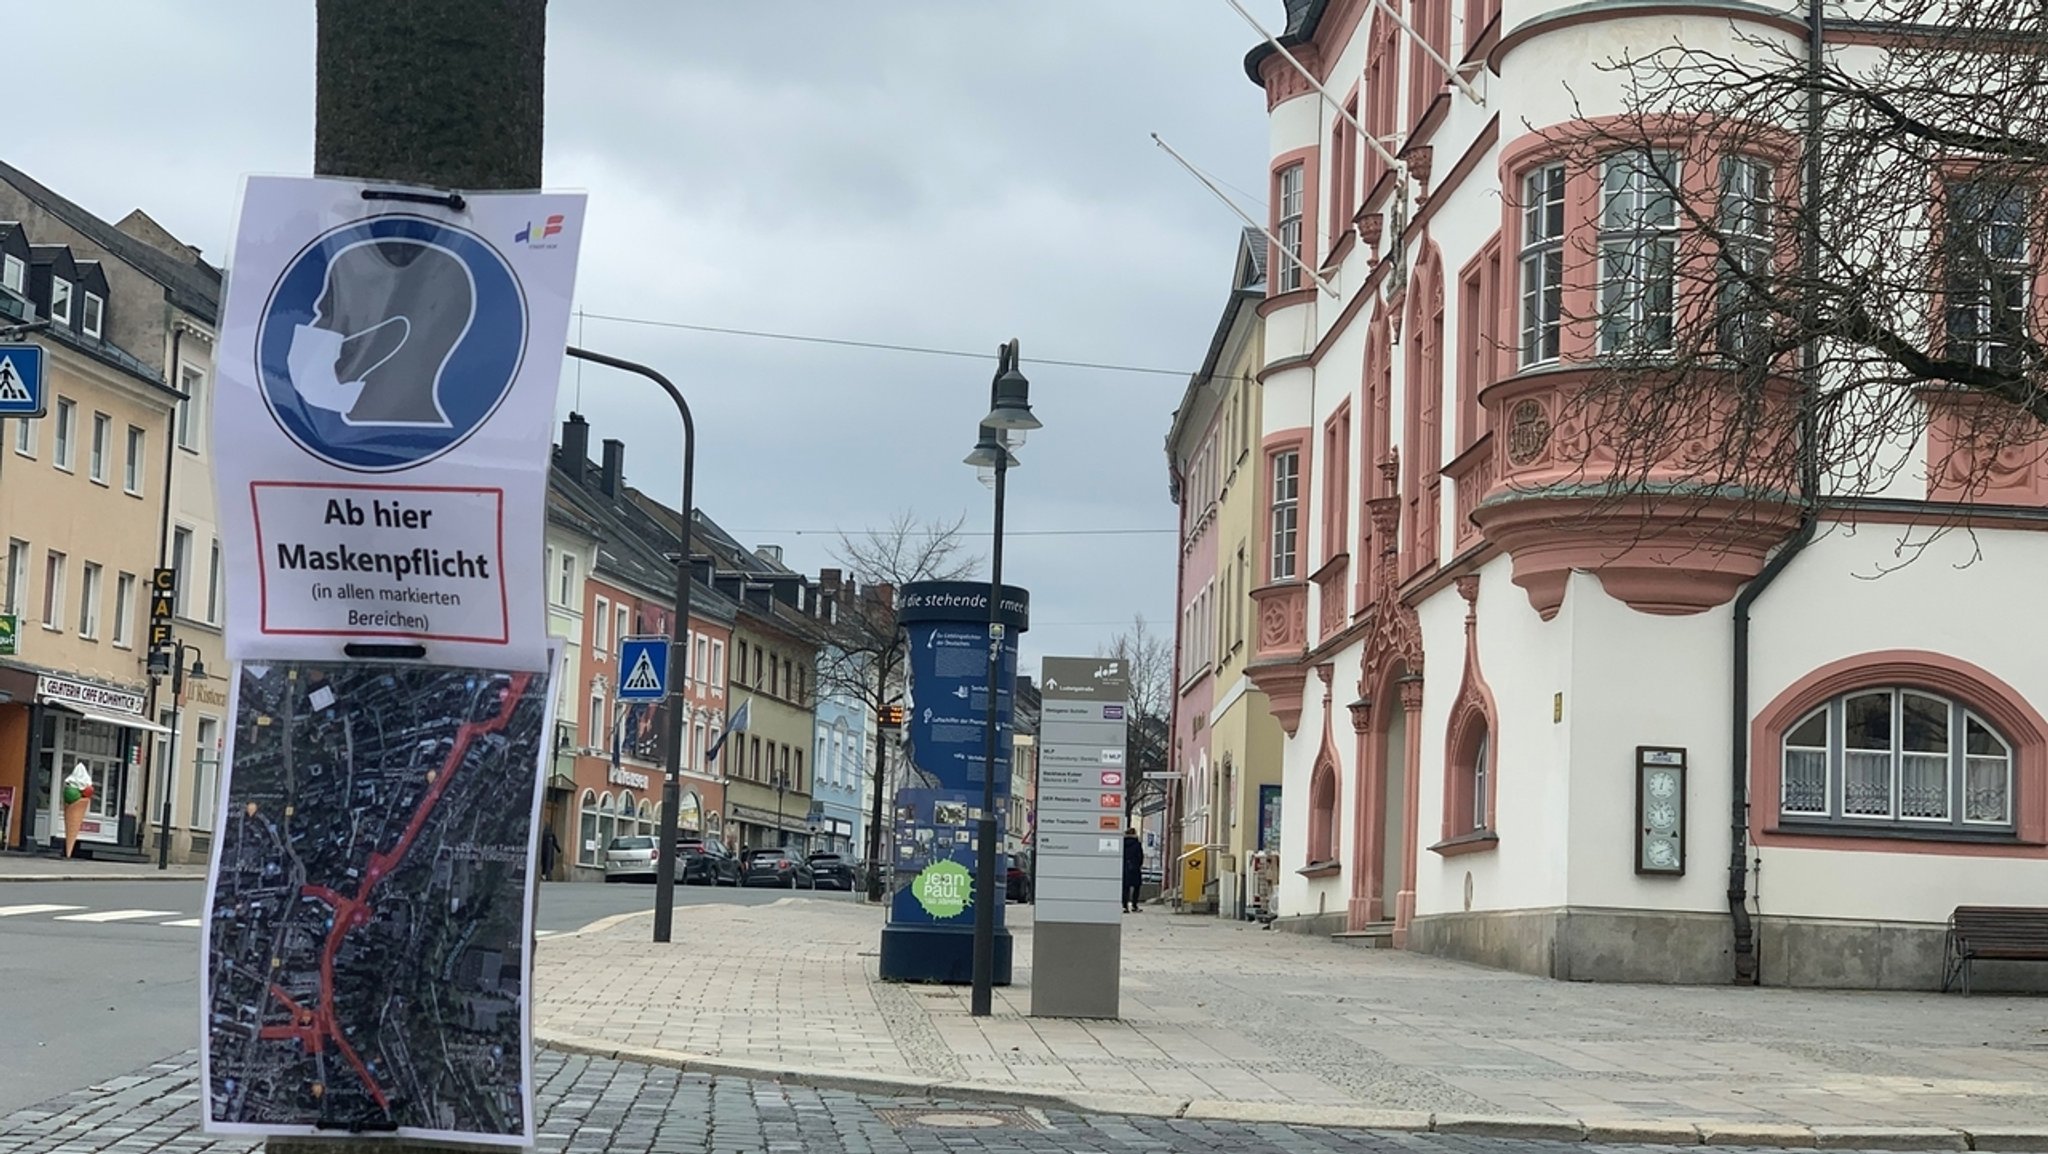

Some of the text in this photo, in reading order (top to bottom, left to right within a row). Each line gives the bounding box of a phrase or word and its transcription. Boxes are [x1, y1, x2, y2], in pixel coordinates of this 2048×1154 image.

[324, 498, 432, 529] Ab hier
[277, 543, 489, 581] Maskenpflicht
[312, 582, 461, 606] (in allen markierten
[907, 593, 921, 608] die
[924, 592, 988, 608] stehende
[1000, 599, 1024, 614] rmee
[348, 610, 429, 632] Bereichen)
[82, 686, 98, 702] CAFE
[98, 690, 135, 708] ROMANTICA
